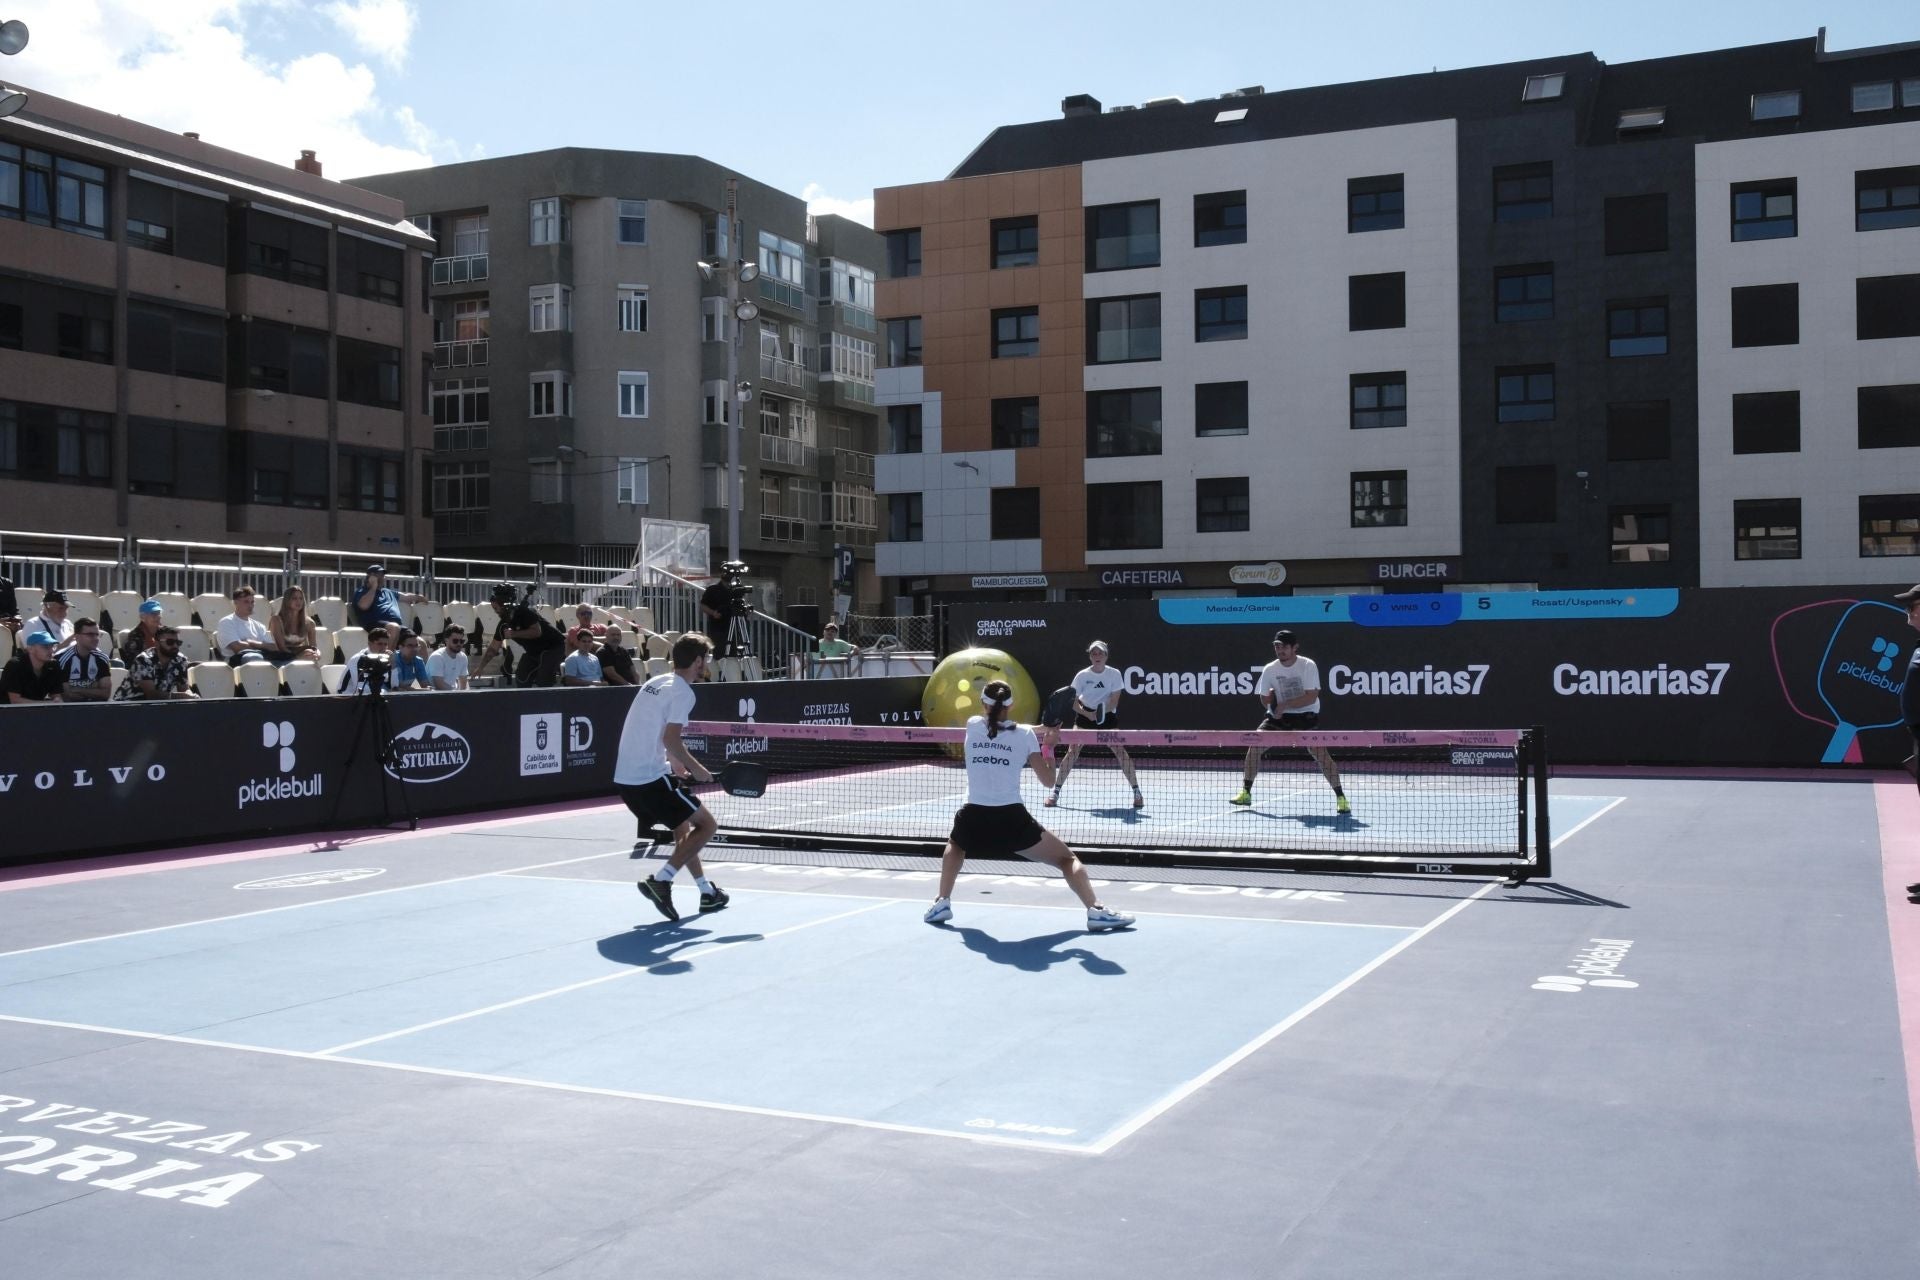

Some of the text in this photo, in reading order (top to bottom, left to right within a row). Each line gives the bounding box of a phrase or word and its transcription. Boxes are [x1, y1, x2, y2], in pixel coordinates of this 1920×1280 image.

[843, 551, 852, 575] P
[1101, 570, 1183, 585] CAFETERIA
[1266, 567, 1280, 581] 18
[1378, 563, 1448, 578] BURGER
[973, 576, 1047, 587] HAMBURGUESERIA
[1321, 600, 1333, 613] 7
[1390, 603, 1418, 612] WINS
[1477, 598, 1491, 610] 5
[1531, 596, 1624, 608] Rosati/Uspensky
[977, 627, 1002, 636] OPEN
[1328, 664, 1490, 696] Canarias7
[1553, 662, 1730, 696] Canarias7
[1837, 661, 1904, 696] picklebul
[803, 703, 850, 716] CERVEZAS
[880, 710, 922, 723] VOLV
[1459, 736, 1498, 744] VICTORIA
[725, 736, 768, 759] picklebull
[972, 742, 1012, 753] SABRINA
[526, 753, 547, 762] Cabildo
[524, 762, 537, 770] Gran
[538, 760, 558, 769] Canaria
[0, 764, 165, 792] VOLVO
[238, 773, 322, 810] picklebull
[1127, 882, 1347, 903] TOUR
[1567, 938, 1635, 977] picklebull
[0, 1135, 265, 1208] ORIA
